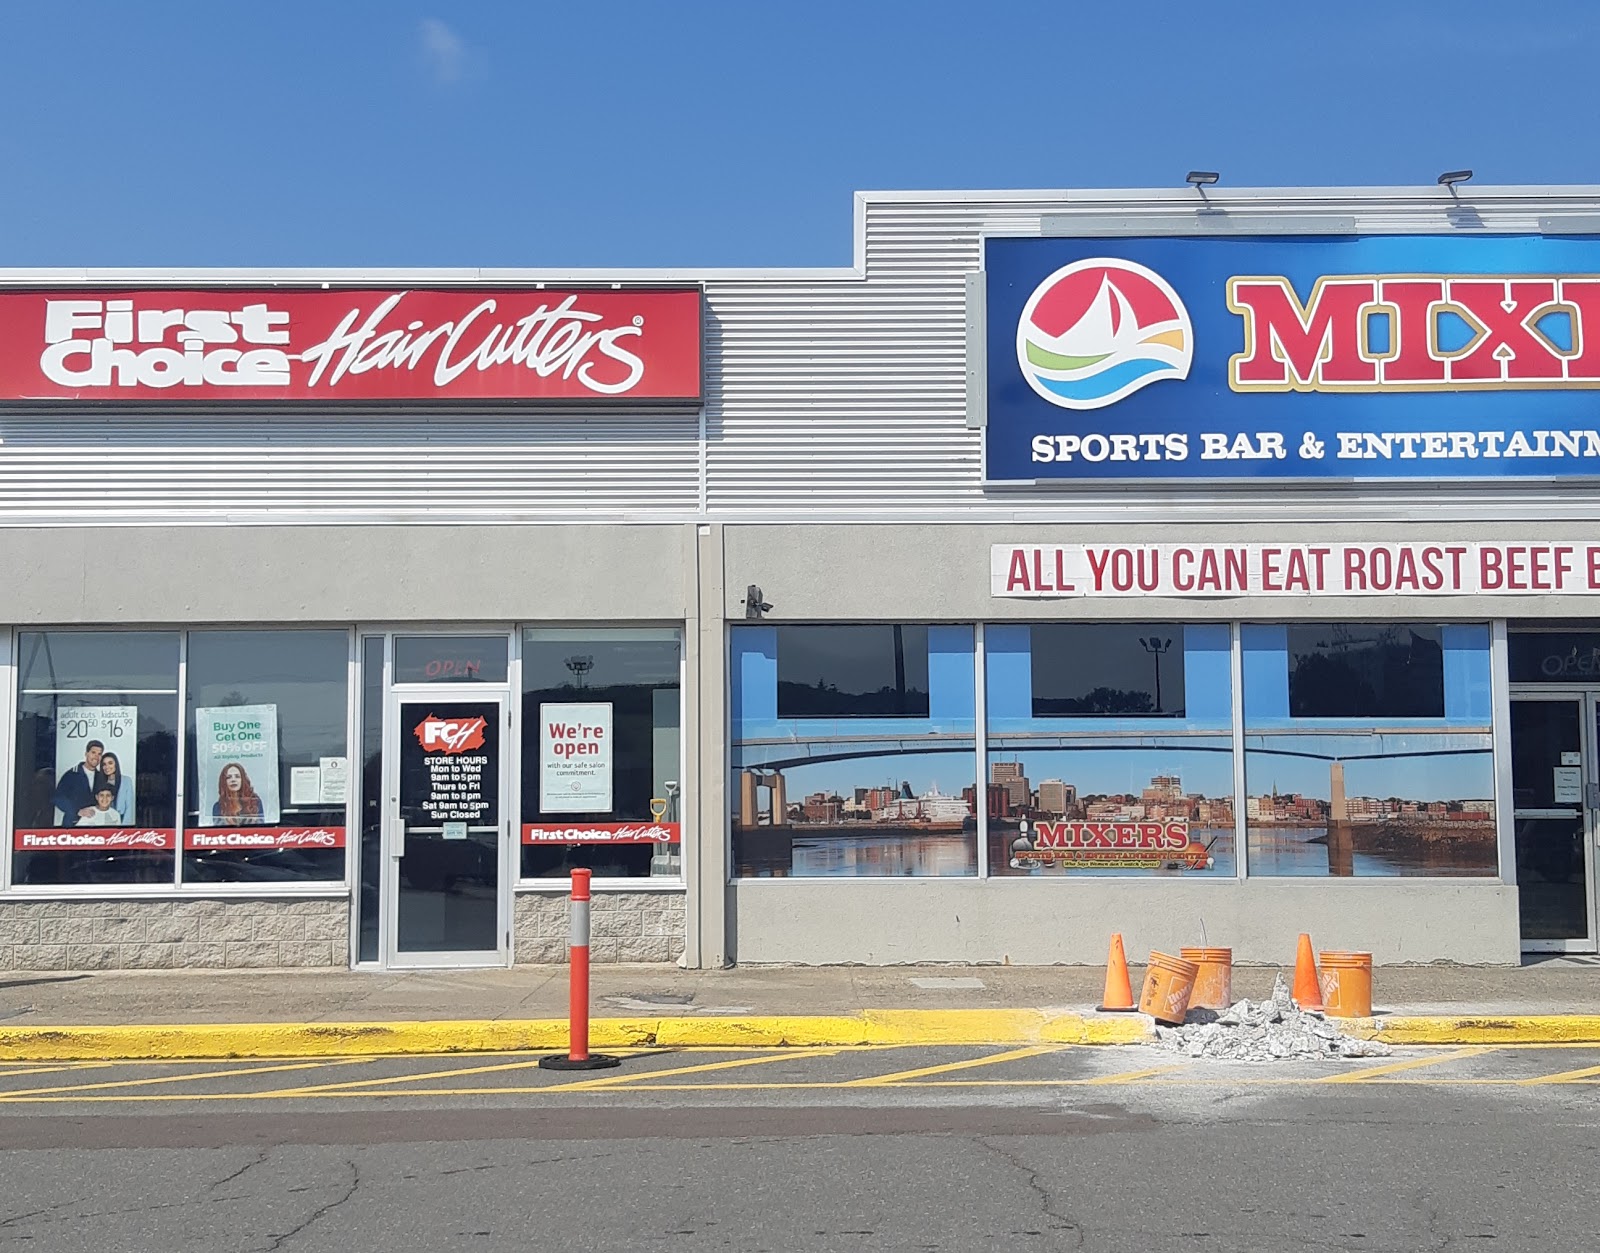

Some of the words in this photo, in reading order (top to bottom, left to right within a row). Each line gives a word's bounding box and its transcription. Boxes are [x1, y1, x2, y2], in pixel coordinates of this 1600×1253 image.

[45, 299, 291, 344] First
[40, 338, 291, 387] Choice
[1031, 433, 1188, 462] SPORTS
[1200, 432, 1287, 460] BAR
[1298, 431, 1324, 459] &
[1006, 548, 1075, 592] ALL
[1086, 548, 1159, 592] YOU
[1172, 547, 1248, 591] CAN
[1262, 547, 1331, 591] EAT
[1344, 546, 1467, 591] ROAST
[1480, 546, 1573, 590] BEEF
[60, 709, 79, 718] adult
[213, 722, 235, 732] Buy
[237, 720, 261, 730] One
[549, 722, 604, 739] We're
[215, 732, 236, 741] Get
[238, 731, 261, 740] One
[424, 720, 482, 749] FCH
[212, 742, 240, 753] 50%
[242, 740, 267, 751] OFF
[553, 742, 599, 760] open
[424, 757, 454, 765] STORE
[456, 756, 488, 764] HOURS
[462, 764, 481, 772] Wed
[430, 773, 449, 781] 9am
[432, 782, 456, 790] Thurs
[469, 782, 480, 790] Fri
[430, 792, 449, 800] 9am
[422, 801, 437, 809] Sat
[431, 811, 448, 819] Sun
[450, 810, 480, 819] Closed
[23, 834, 57, 846] First
[57, 833, 105, 846] Choice
[192, 833, 226, 846] First
[226, 832, 274, 845] Choice
[531, 828, 564, 840] First
[564, 828, 612, 840] Choice
[1034, 821, 1189, 850] MIXERS
